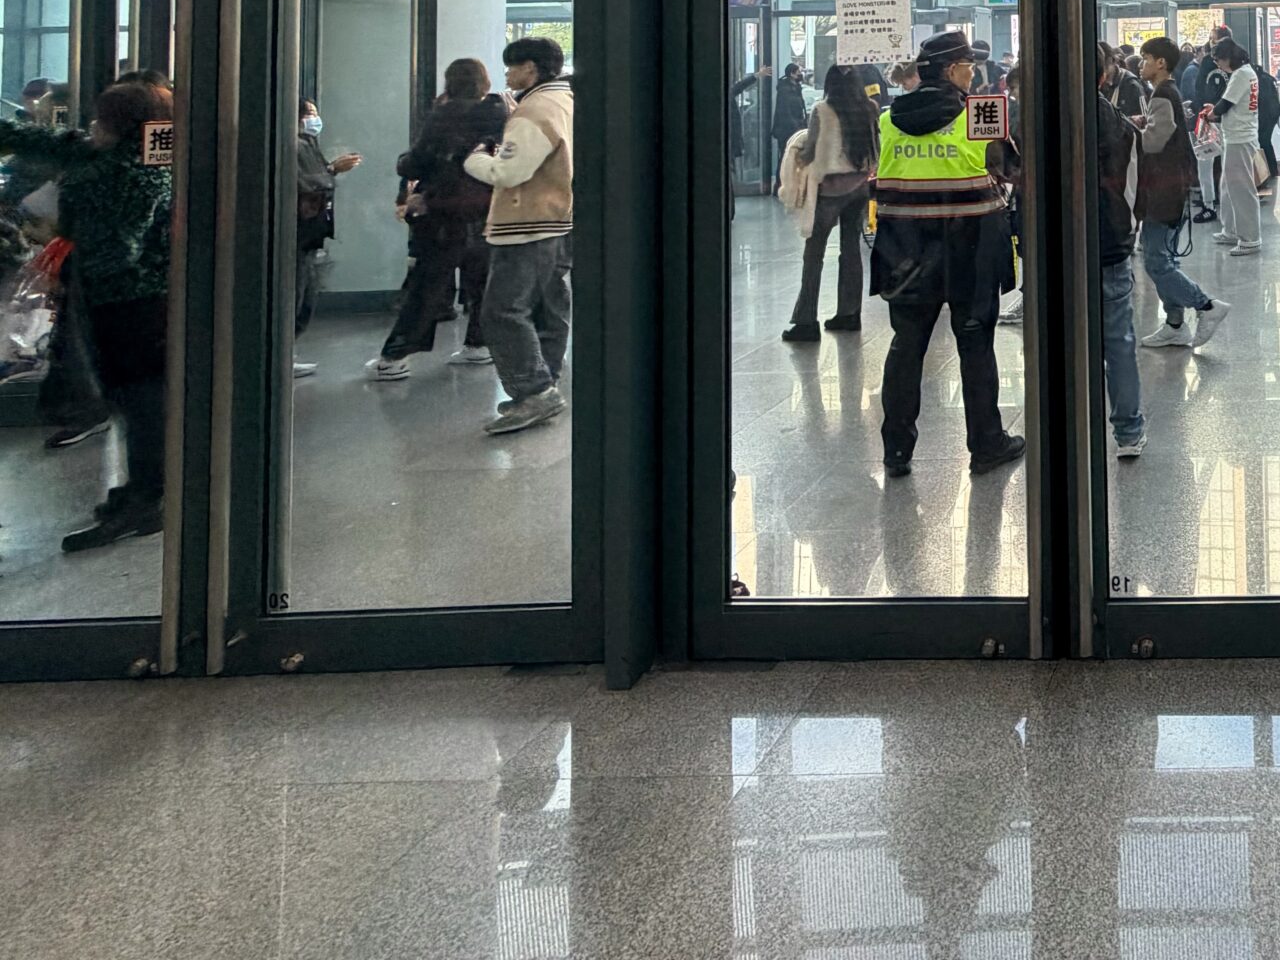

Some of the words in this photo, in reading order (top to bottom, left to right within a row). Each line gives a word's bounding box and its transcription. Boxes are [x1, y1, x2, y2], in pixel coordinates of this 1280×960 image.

[974, 101, 999, 124] 推
[150, 128, 173, 150] 推
[973, 127, 1000, 135] PUSH
[894, 143, 959, 159] POLICE
